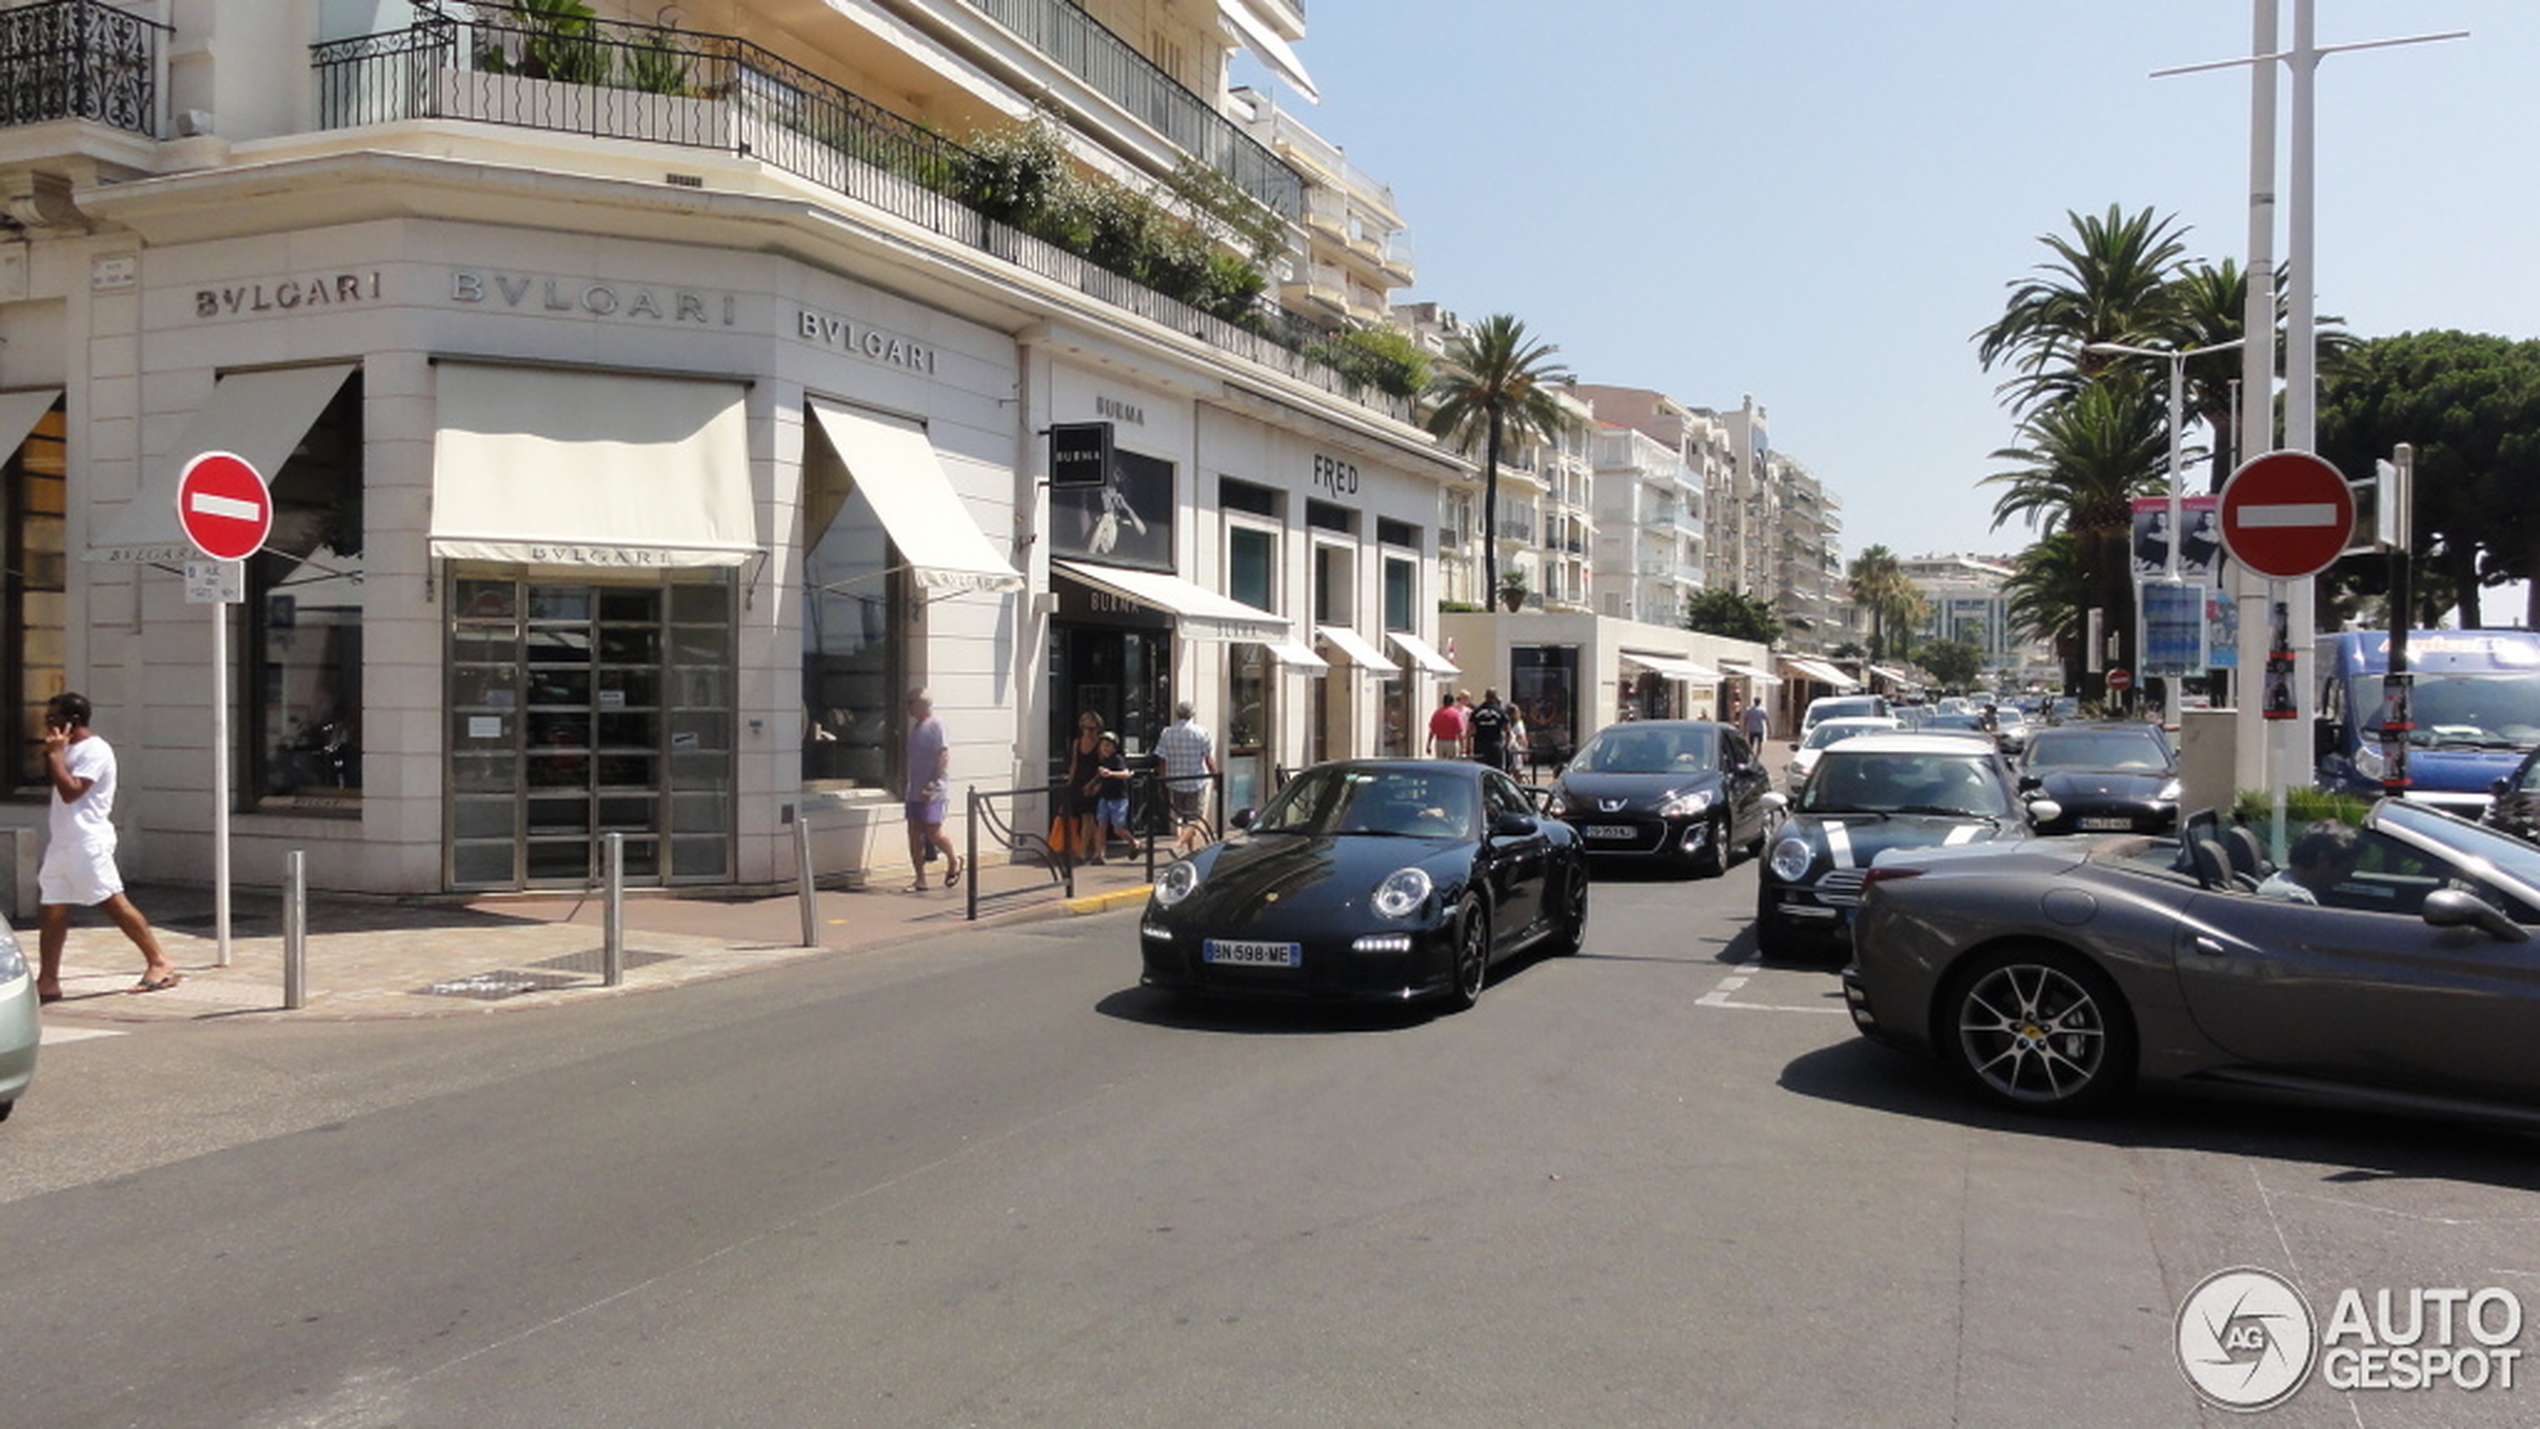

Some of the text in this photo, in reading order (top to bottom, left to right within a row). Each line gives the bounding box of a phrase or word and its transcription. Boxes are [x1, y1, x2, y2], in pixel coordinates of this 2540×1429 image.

[196, 271, 381, 318] BVLGARI
[451, 271, 735, 325] BVLGARI
[799, 311, 938, 375] BVLGARI
[1314, 453, 1358, 499] FRED
[531, 547, 667, 564] BVLGARI
